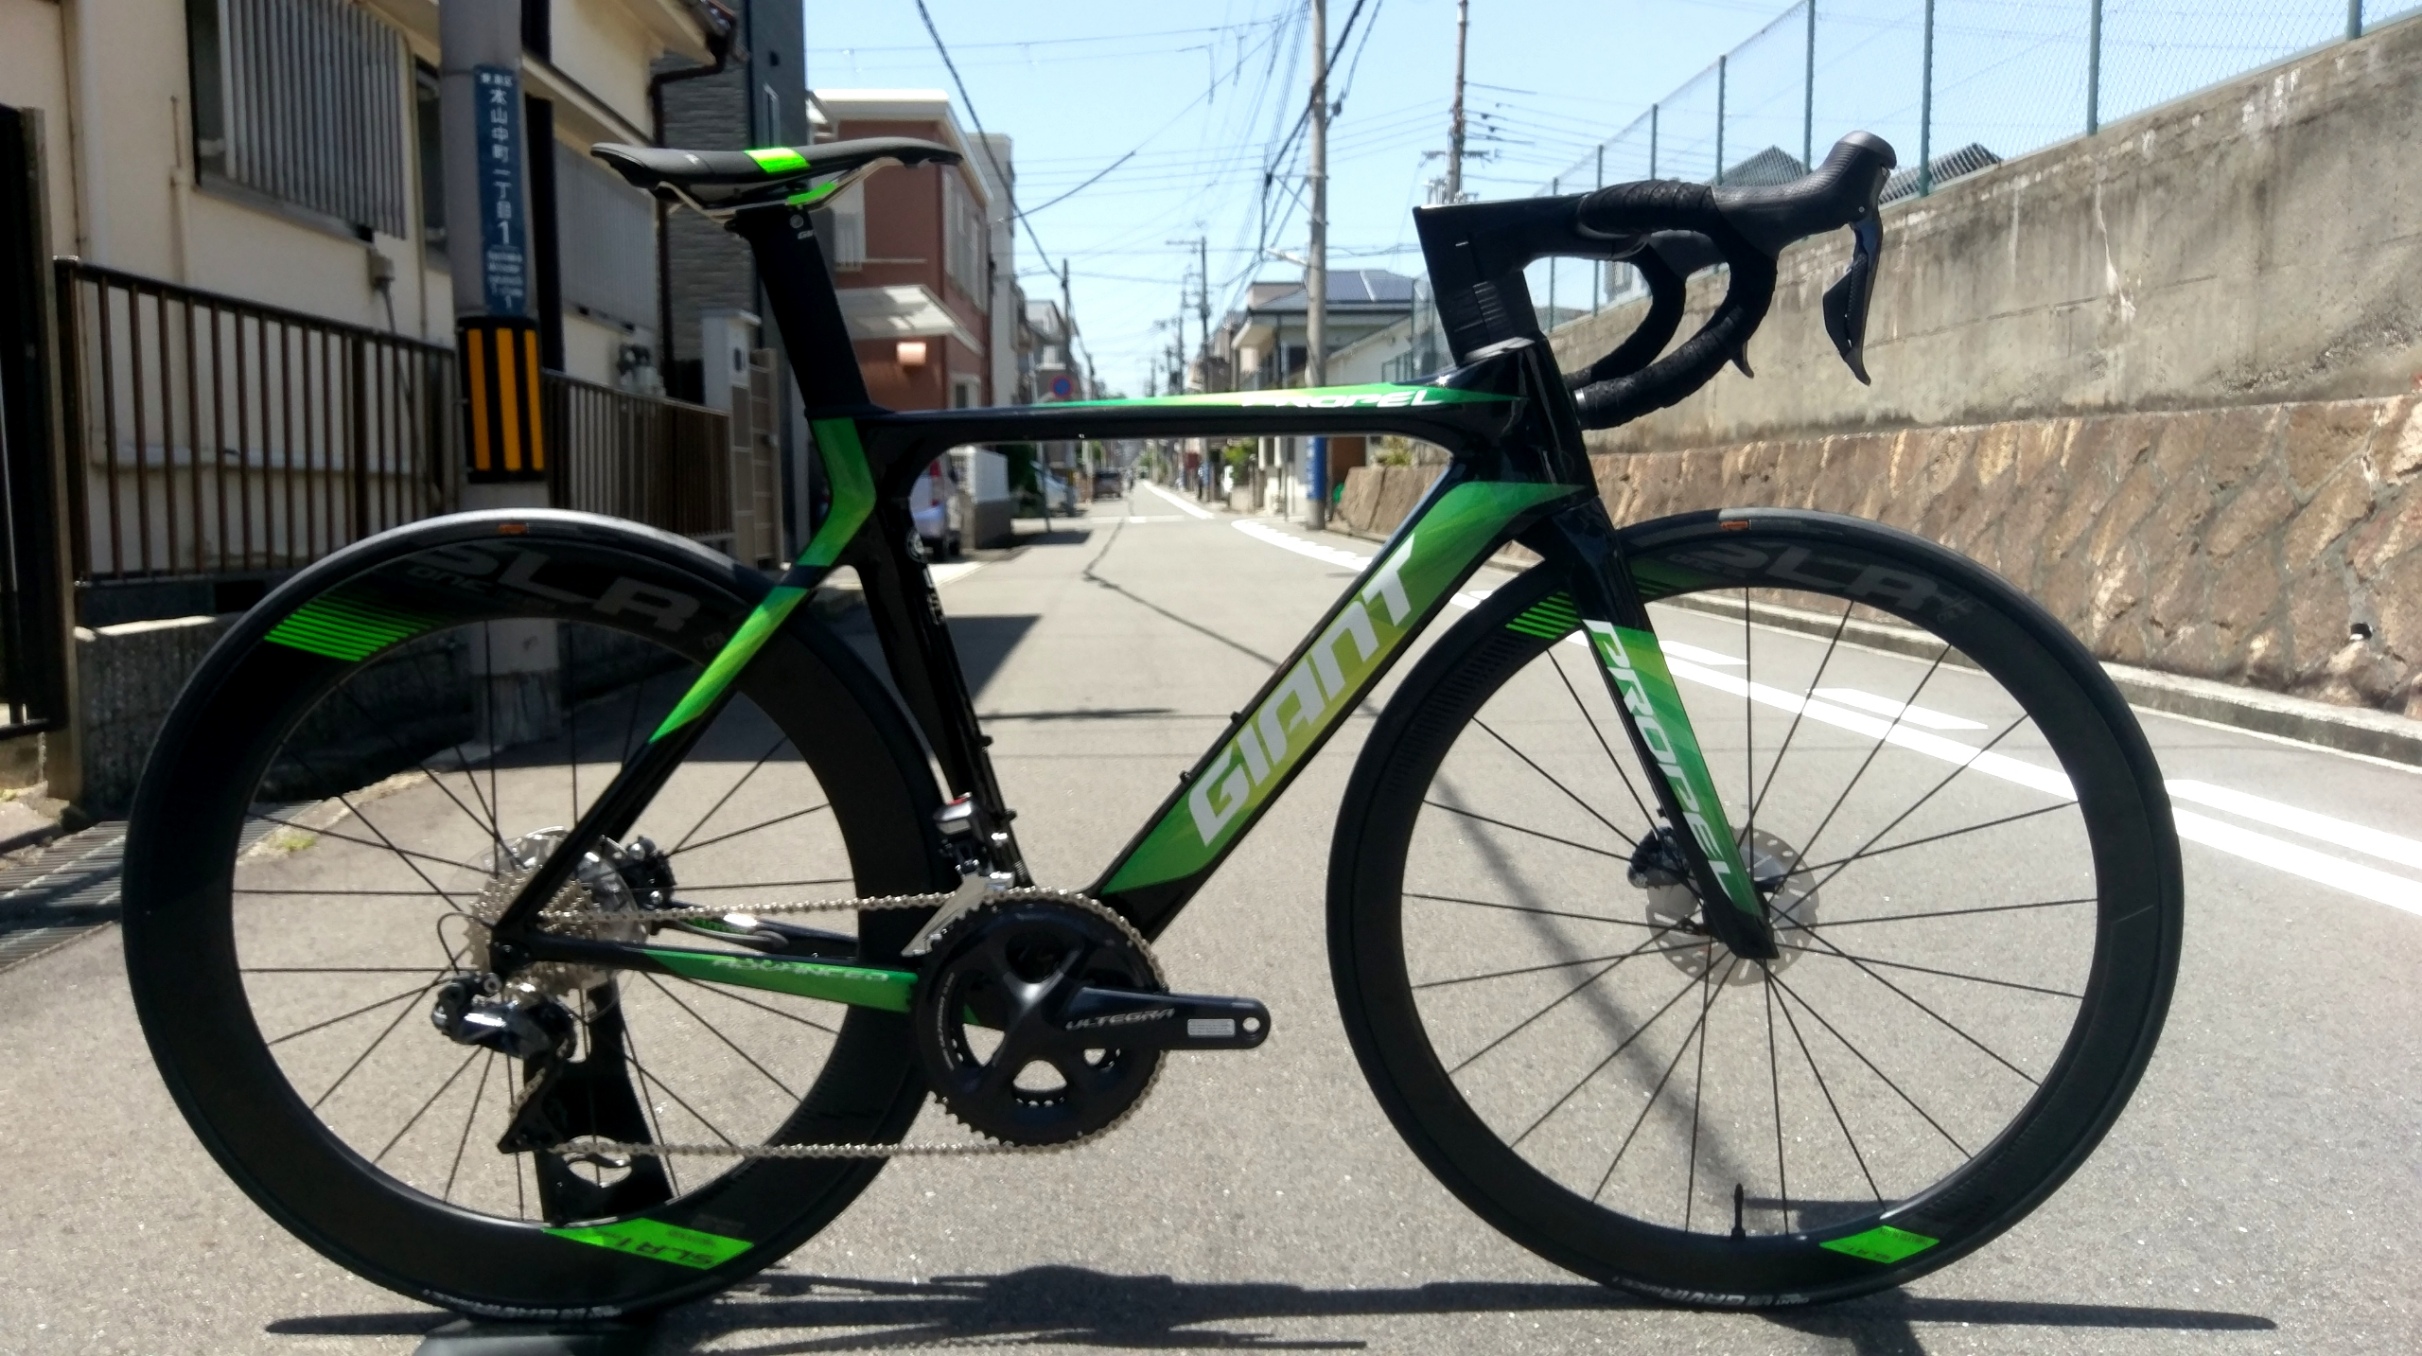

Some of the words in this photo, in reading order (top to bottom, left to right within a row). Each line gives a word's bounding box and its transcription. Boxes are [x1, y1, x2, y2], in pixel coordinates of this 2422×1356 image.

[1188, 532, 1416, 848] GIANT
[1582, 619, 1735, 901] PROPEL
[1065, 1007, 1176, 1032] ULTEGRA
